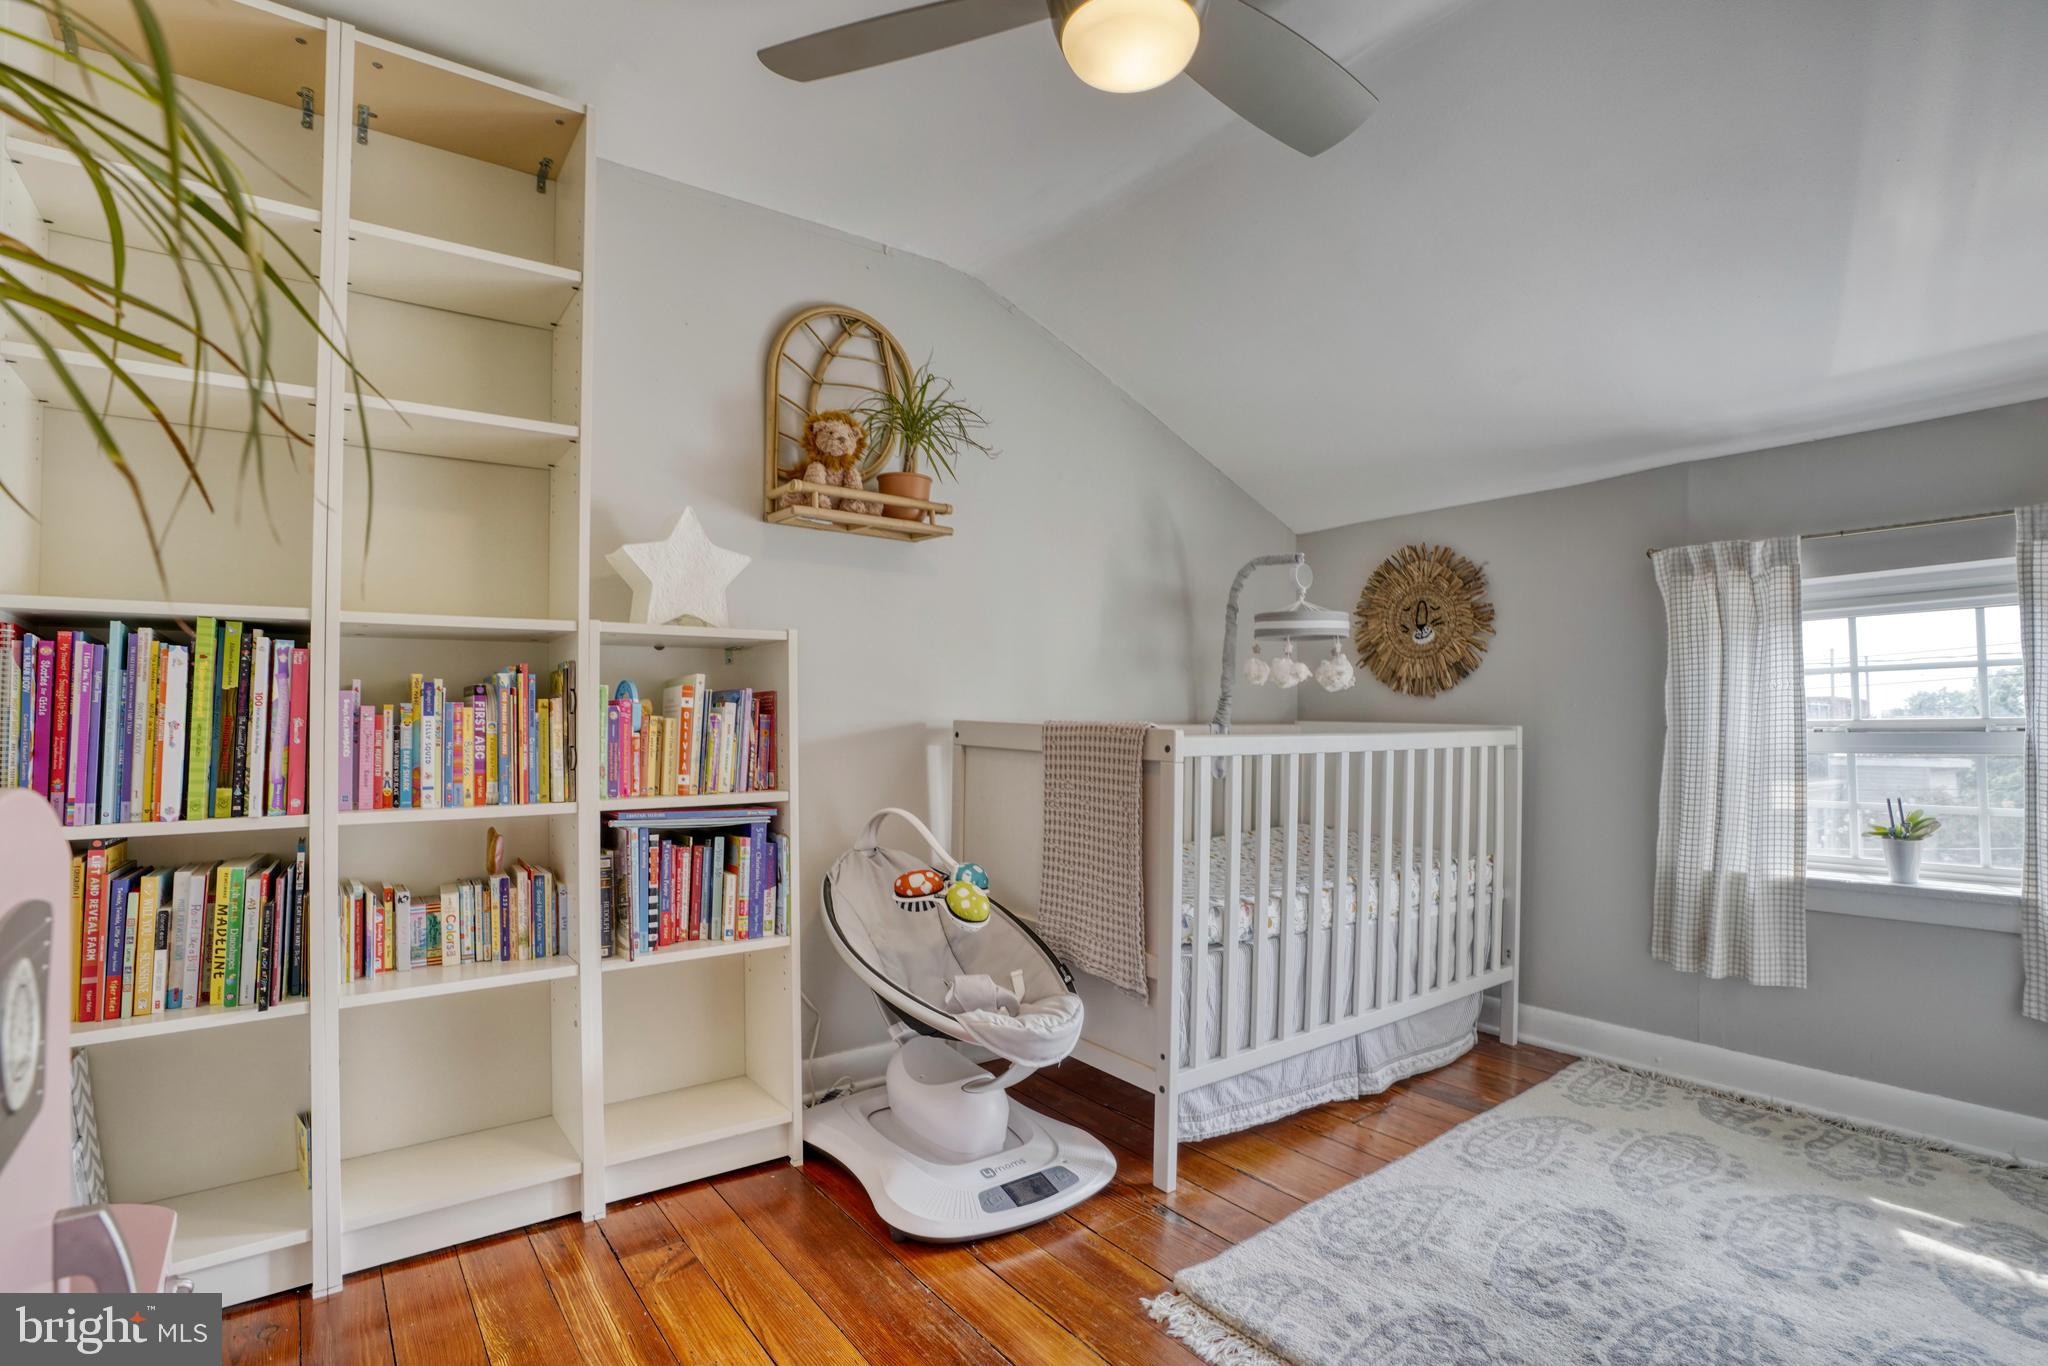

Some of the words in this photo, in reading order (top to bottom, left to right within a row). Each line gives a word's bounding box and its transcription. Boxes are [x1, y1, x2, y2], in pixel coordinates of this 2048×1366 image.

[40, 660, 50, 686] Stories
[56, 679, 67, 701] Snuggle
[255, 693, 264, 706] 100
[38, 697, 47, 716] Girls
[475, 701, 485, 732] FIRST
[57, 710, 65, 731] Stories
[475, 736, 485, 760] ABC
[682, 711, 690, 770] OLIVIA
[402, 750, 411, 767] BABY
[91, 855, 102, 874] LIFT
[90, 878, 99, 896] AND
[88, 899, 99, 935] REVEAL
[114, 907, 122, 926] Twinkle,
[143, 899, 153, 918] WILL
[142, 920, 152, 936] YOU
[446, 914, 456, 951] Colors
[87, 937, 97, 961] FARM
[227, 928, 239, 970] Dinoshapes
[138, 953, 149, 993] SUNSHINE
[109, 980, 118, 995] tiger
[109, 997, 117, 1012] tales
